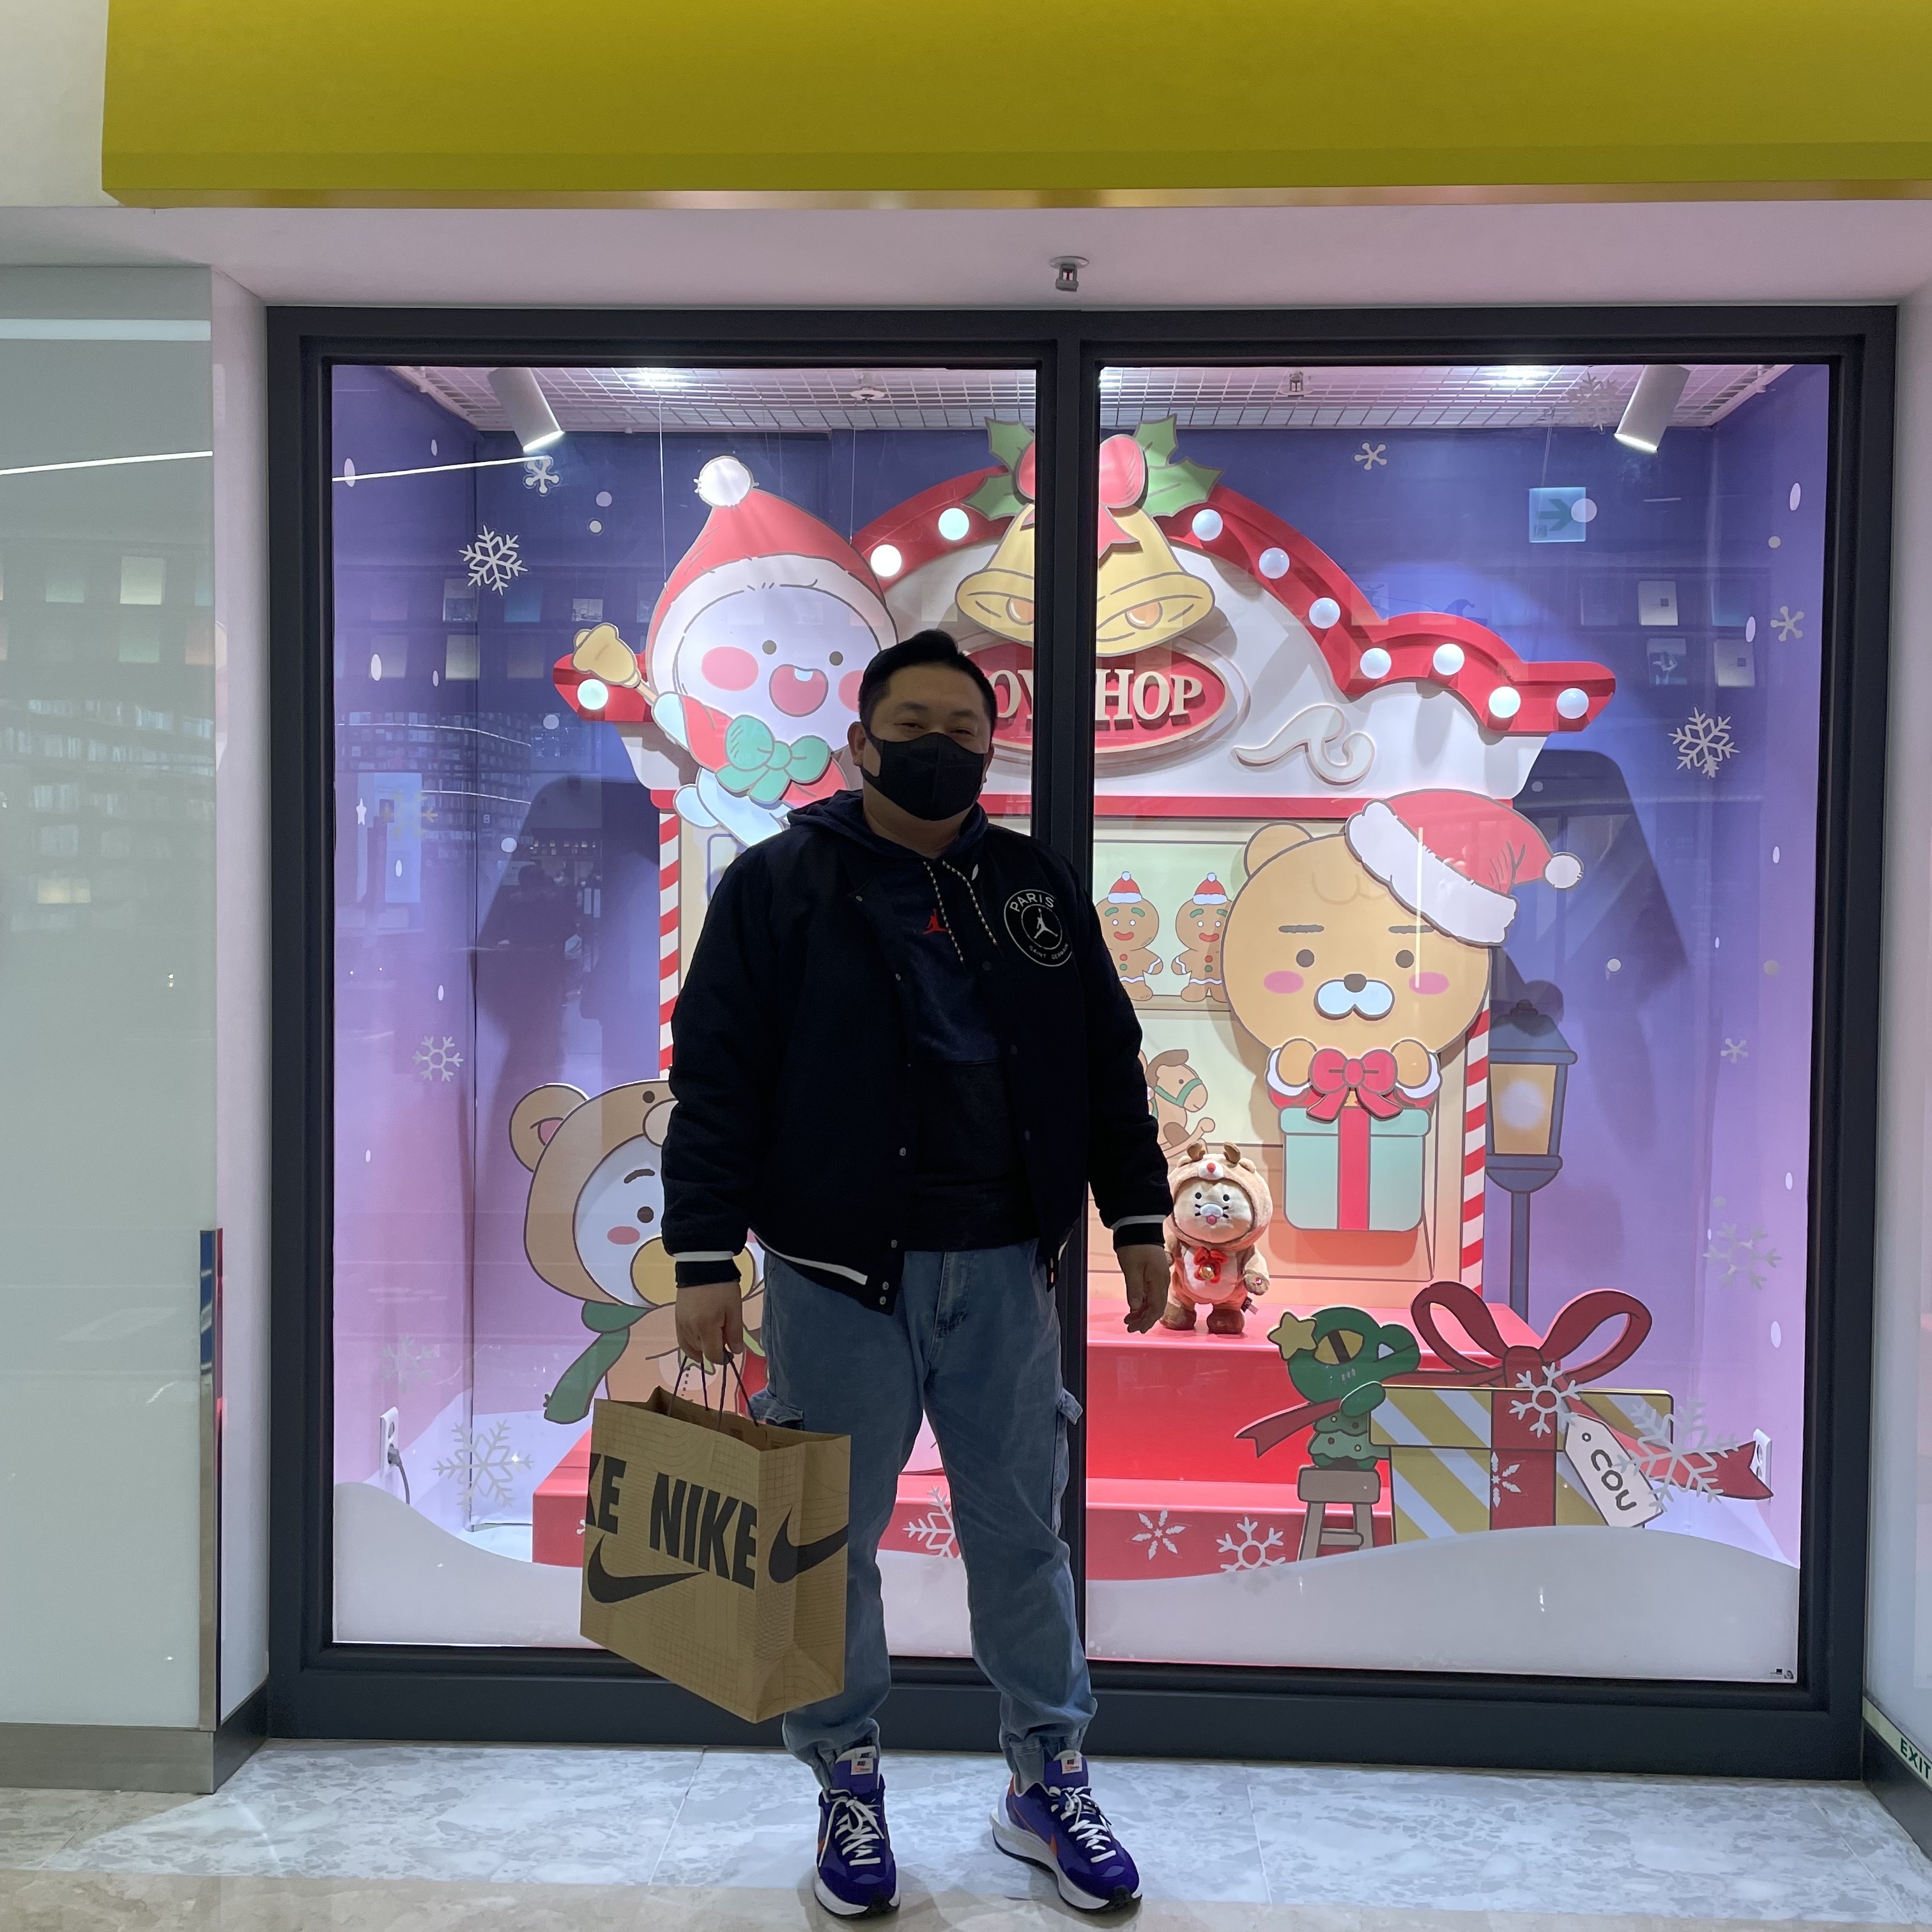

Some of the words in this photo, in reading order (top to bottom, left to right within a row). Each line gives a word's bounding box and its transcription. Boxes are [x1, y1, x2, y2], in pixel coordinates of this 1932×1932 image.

[1095, 668, 1202, 720] HOP
[1009, 893, 1054, 912] PARIS
[649, 1471, 758, 1590] NIKE
[1900, 1737, 1931, 1780] EXIT
